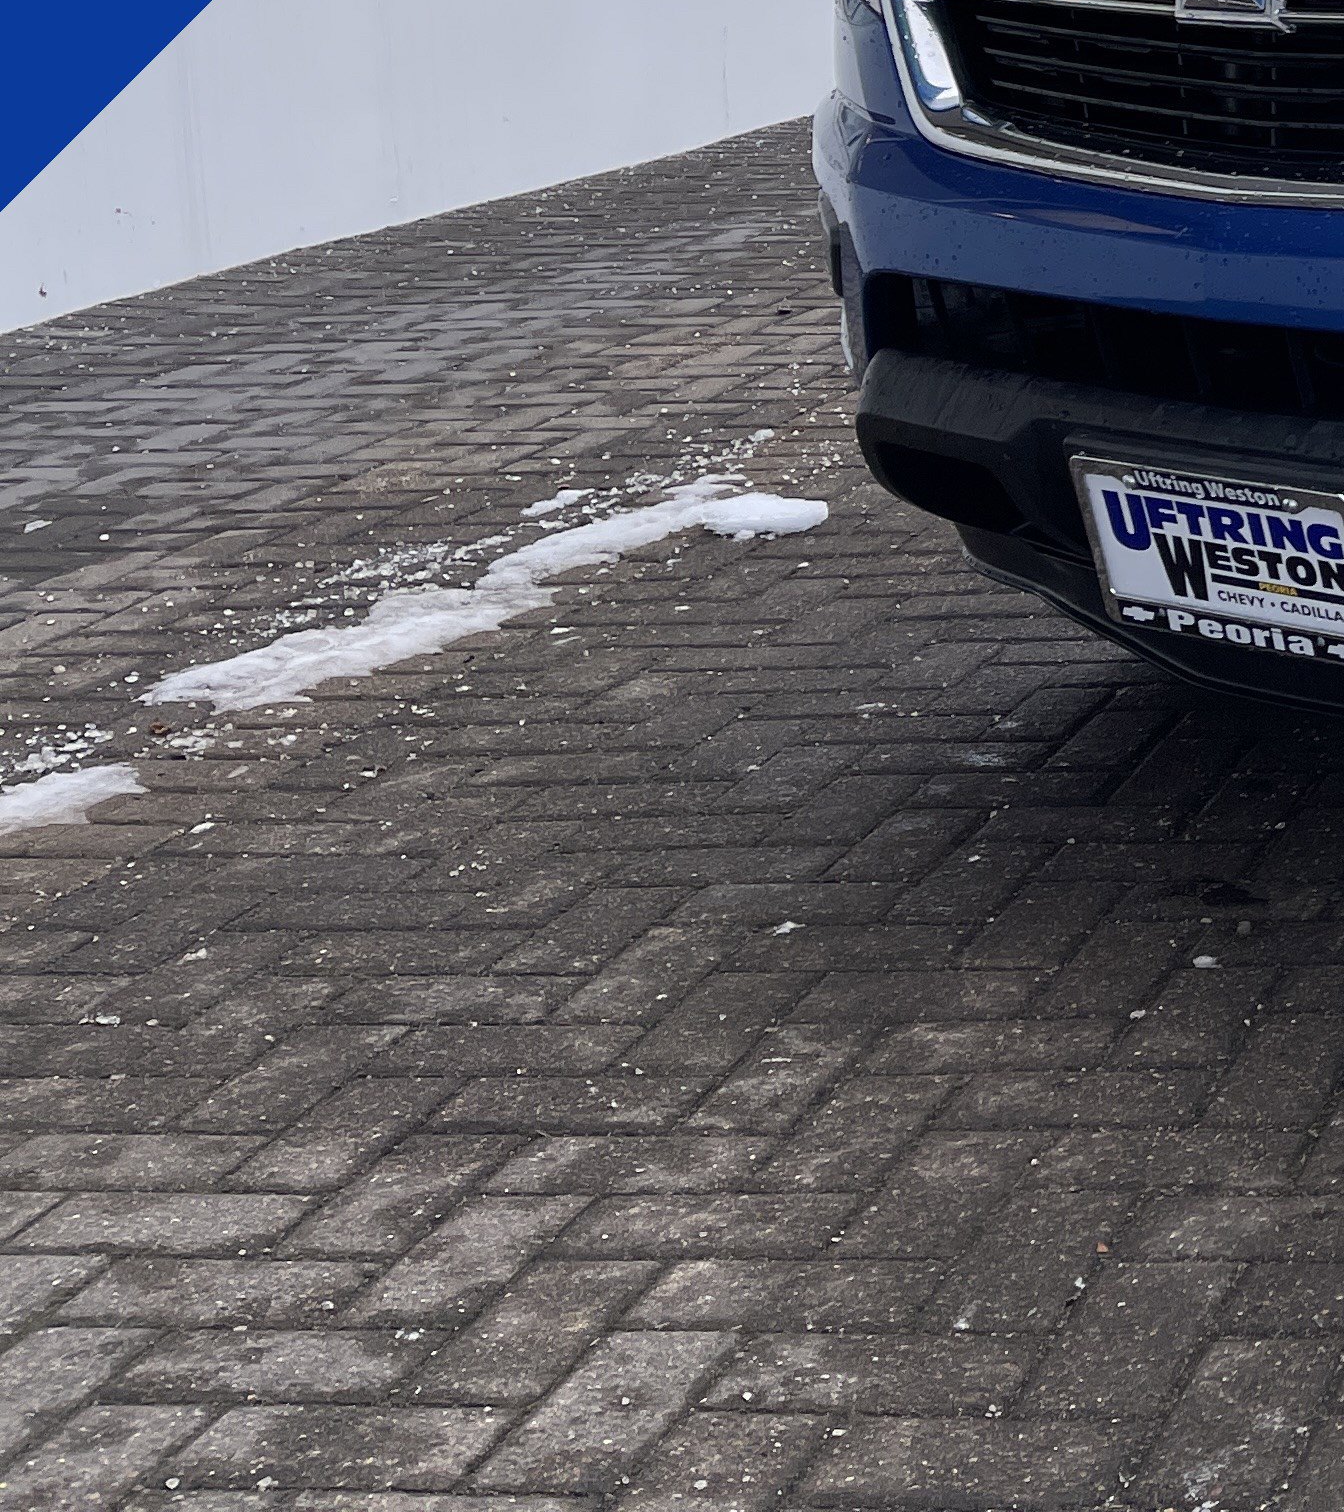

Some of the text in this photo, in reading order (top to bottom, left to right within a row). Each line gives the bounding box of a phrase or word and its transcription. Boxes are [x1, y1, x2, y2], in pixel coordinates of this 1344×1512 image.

[1134, 470, 1281, 507] Uftring Weston
[1102, 490, 1344, 559] UFTRING
[1218, 591, 1265, 608] CHEVY
[1167, 609, 1315, 657] Peoria
